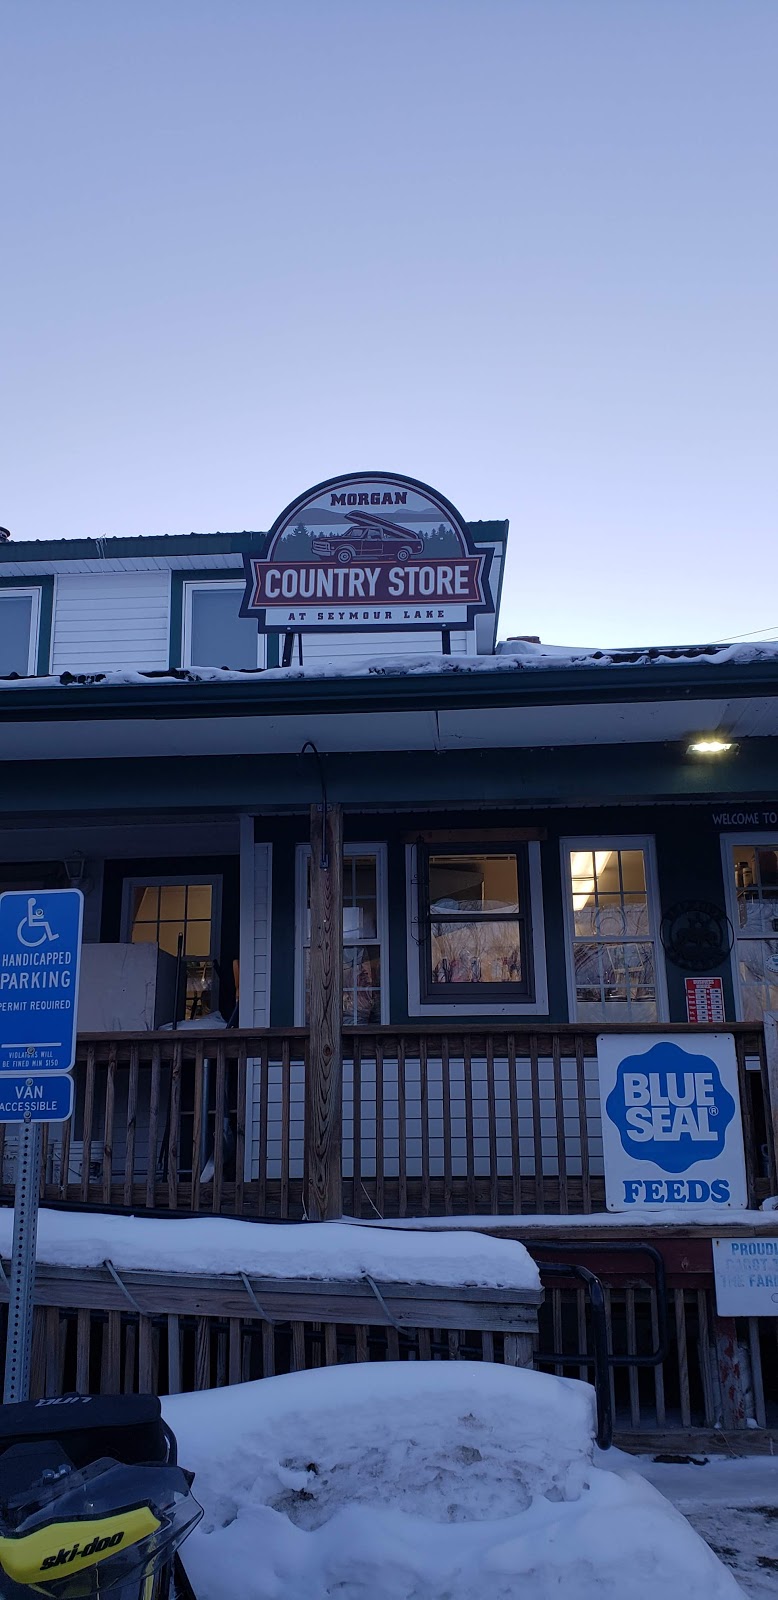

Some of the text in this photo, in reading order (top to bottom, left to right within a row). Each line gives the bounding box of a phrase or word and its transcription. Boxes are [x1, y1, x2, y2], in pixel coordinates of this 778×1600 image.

[330, 491, 408, 507] MORGAN
[264, 565, 470, 599] COUNTRY STORE
[288, 609, 446, 621] AT SEYMOUR LAKE
[712, 812, 760, 825] WELCOME
[2, 951, 72, 967] HANDICAPPED
[0, 970, 71, 990] PARKING
[30, 999, 71, 1011] REQUIRED
[41, 1050, 53, 1058] WILL
[2, 1060, 10, 1068] BE
[32, 1059, 43, 1067] MIN
[15, 1085, 43, 1099] VAN
[623, 1072, 715, 1107] BLUE
[623, 1179, 731, 1204] FEEDS
[40, 1531, 125, 1571] ski-doo
